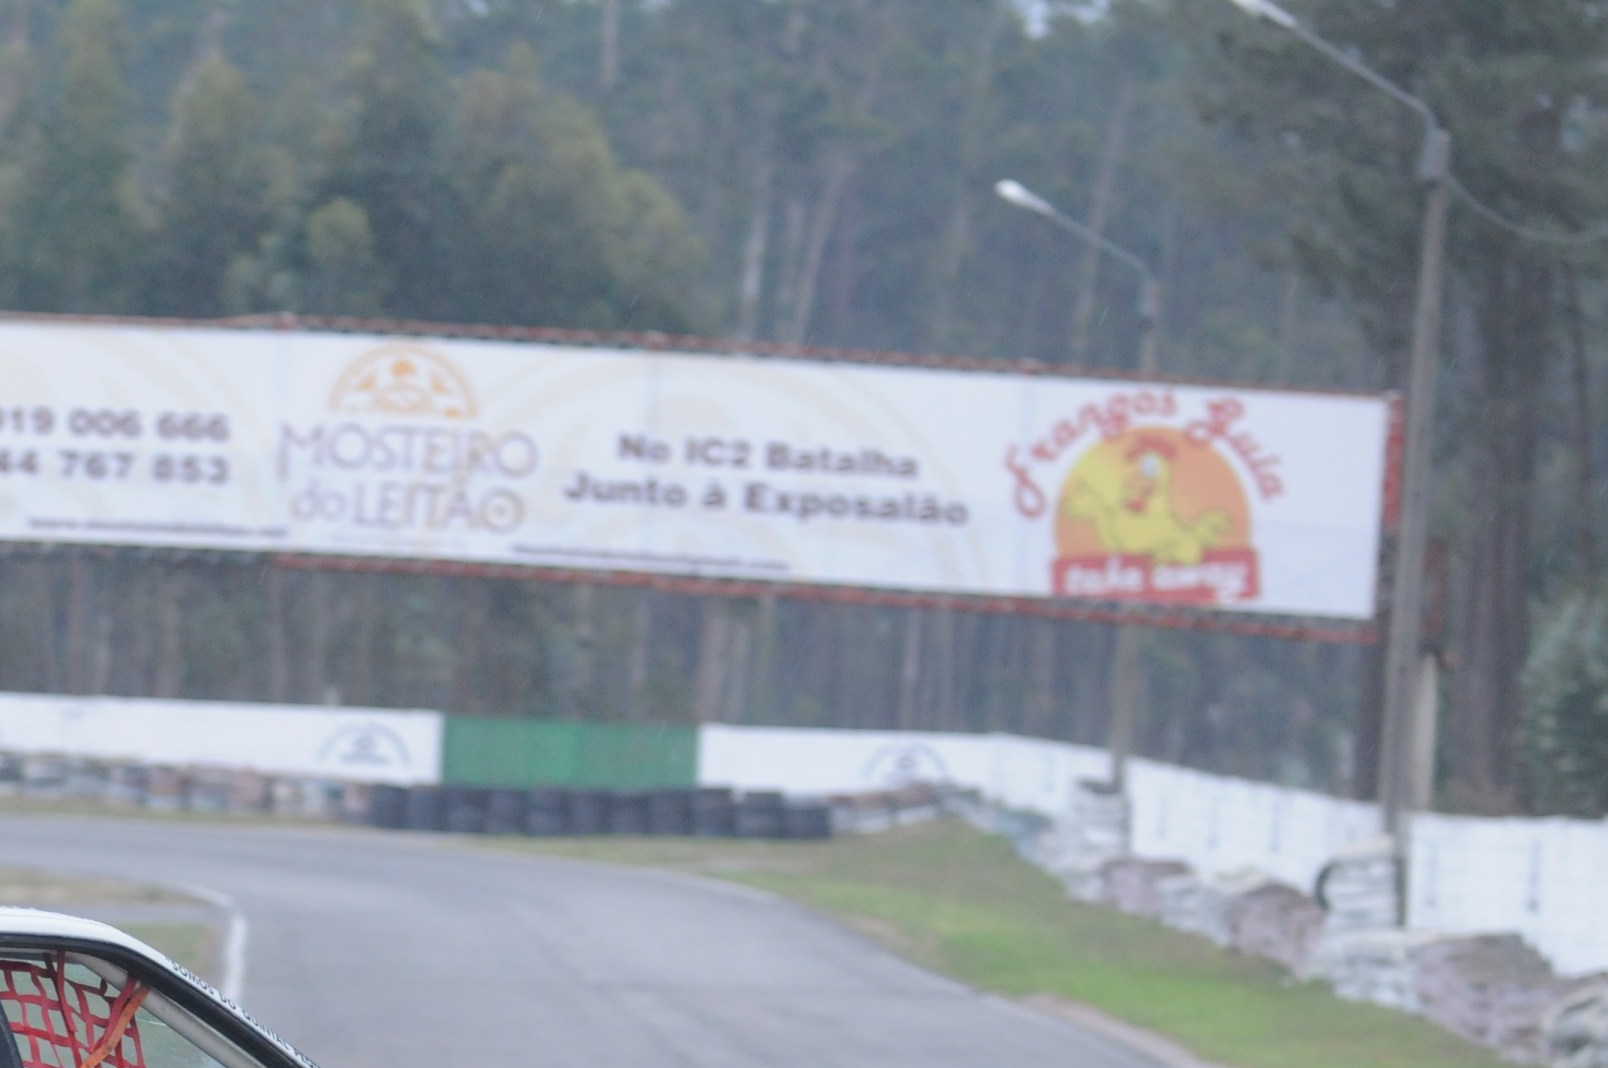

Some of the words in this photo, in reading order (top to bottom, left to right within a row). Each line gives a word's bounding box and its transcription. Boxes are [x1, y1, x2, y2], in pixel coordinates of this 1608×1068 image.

[68, 408, 141, 438] 006
[156, 412, 230, 443] 666
[59, 451, 136, 480] 767
[152, 454, 230, 485] 853
[276, 422, 539, 482] MOSTEIRO
[618, 433, 671, 463] No
[686, 436, 752, 468] IC2
[766, 440, 920, 479] Batalha
[293, 478, 344, 521] do
[564, 470, 688, 508] Junto
[743, 481, 969, 526] Exposalão
